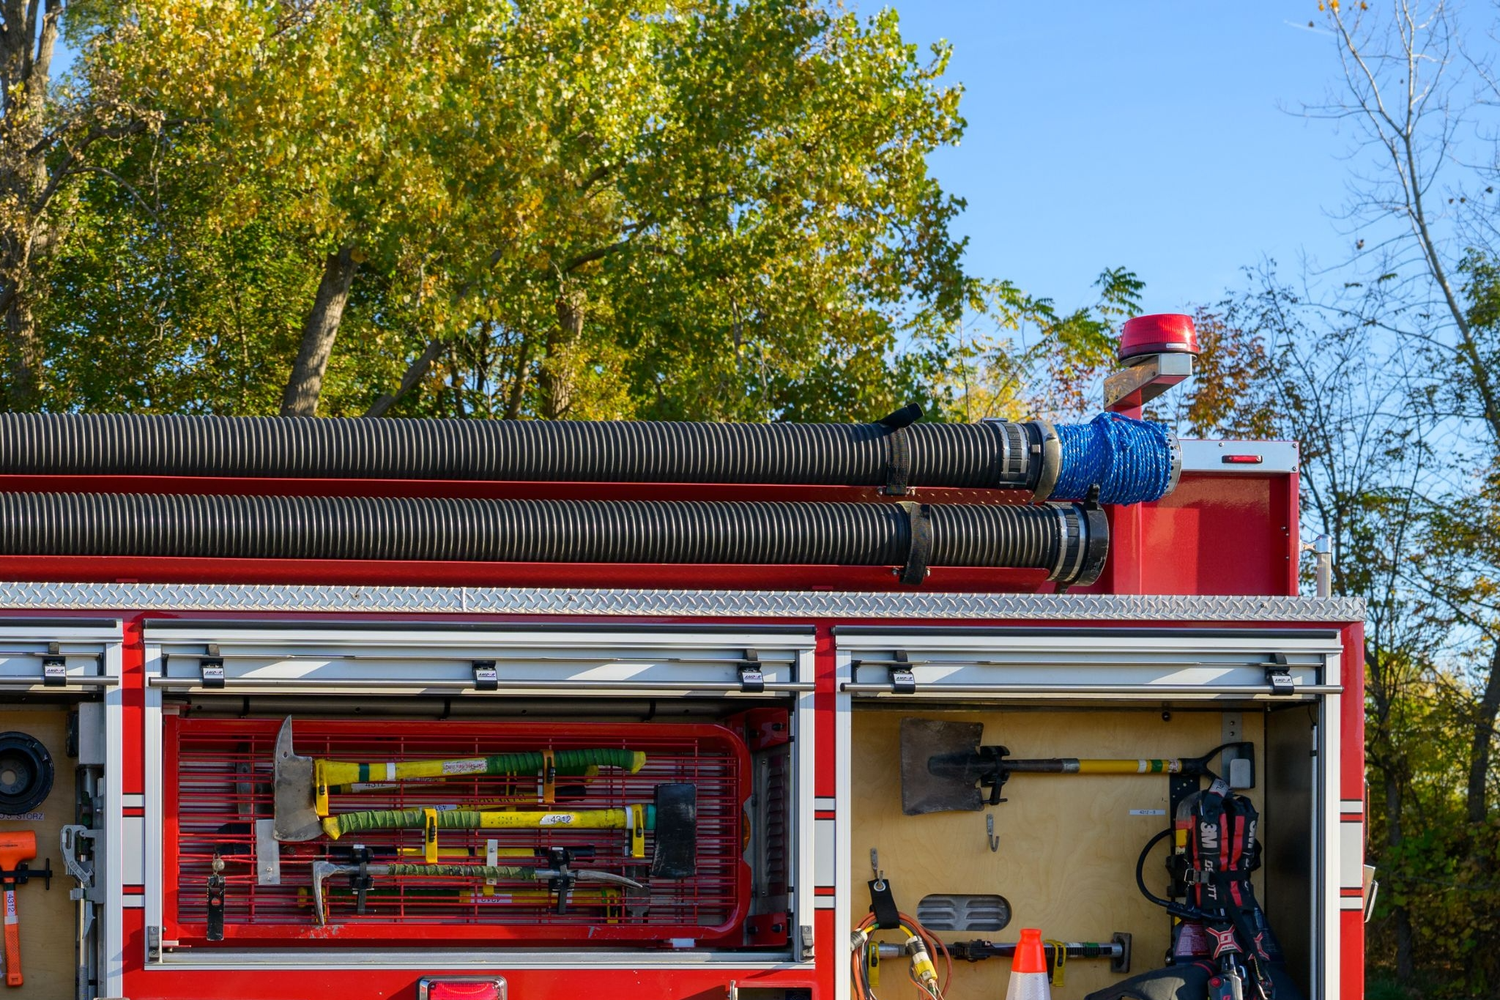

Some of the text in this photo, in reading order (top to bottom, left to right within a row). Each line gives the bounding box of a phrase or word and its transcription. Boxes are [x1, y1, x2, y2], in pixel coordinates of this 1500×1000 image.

[16, 812, 44, 820] STORZ
[550, 815, 571, 824] 4312
[1200, 821, 1218, 849] 3M
